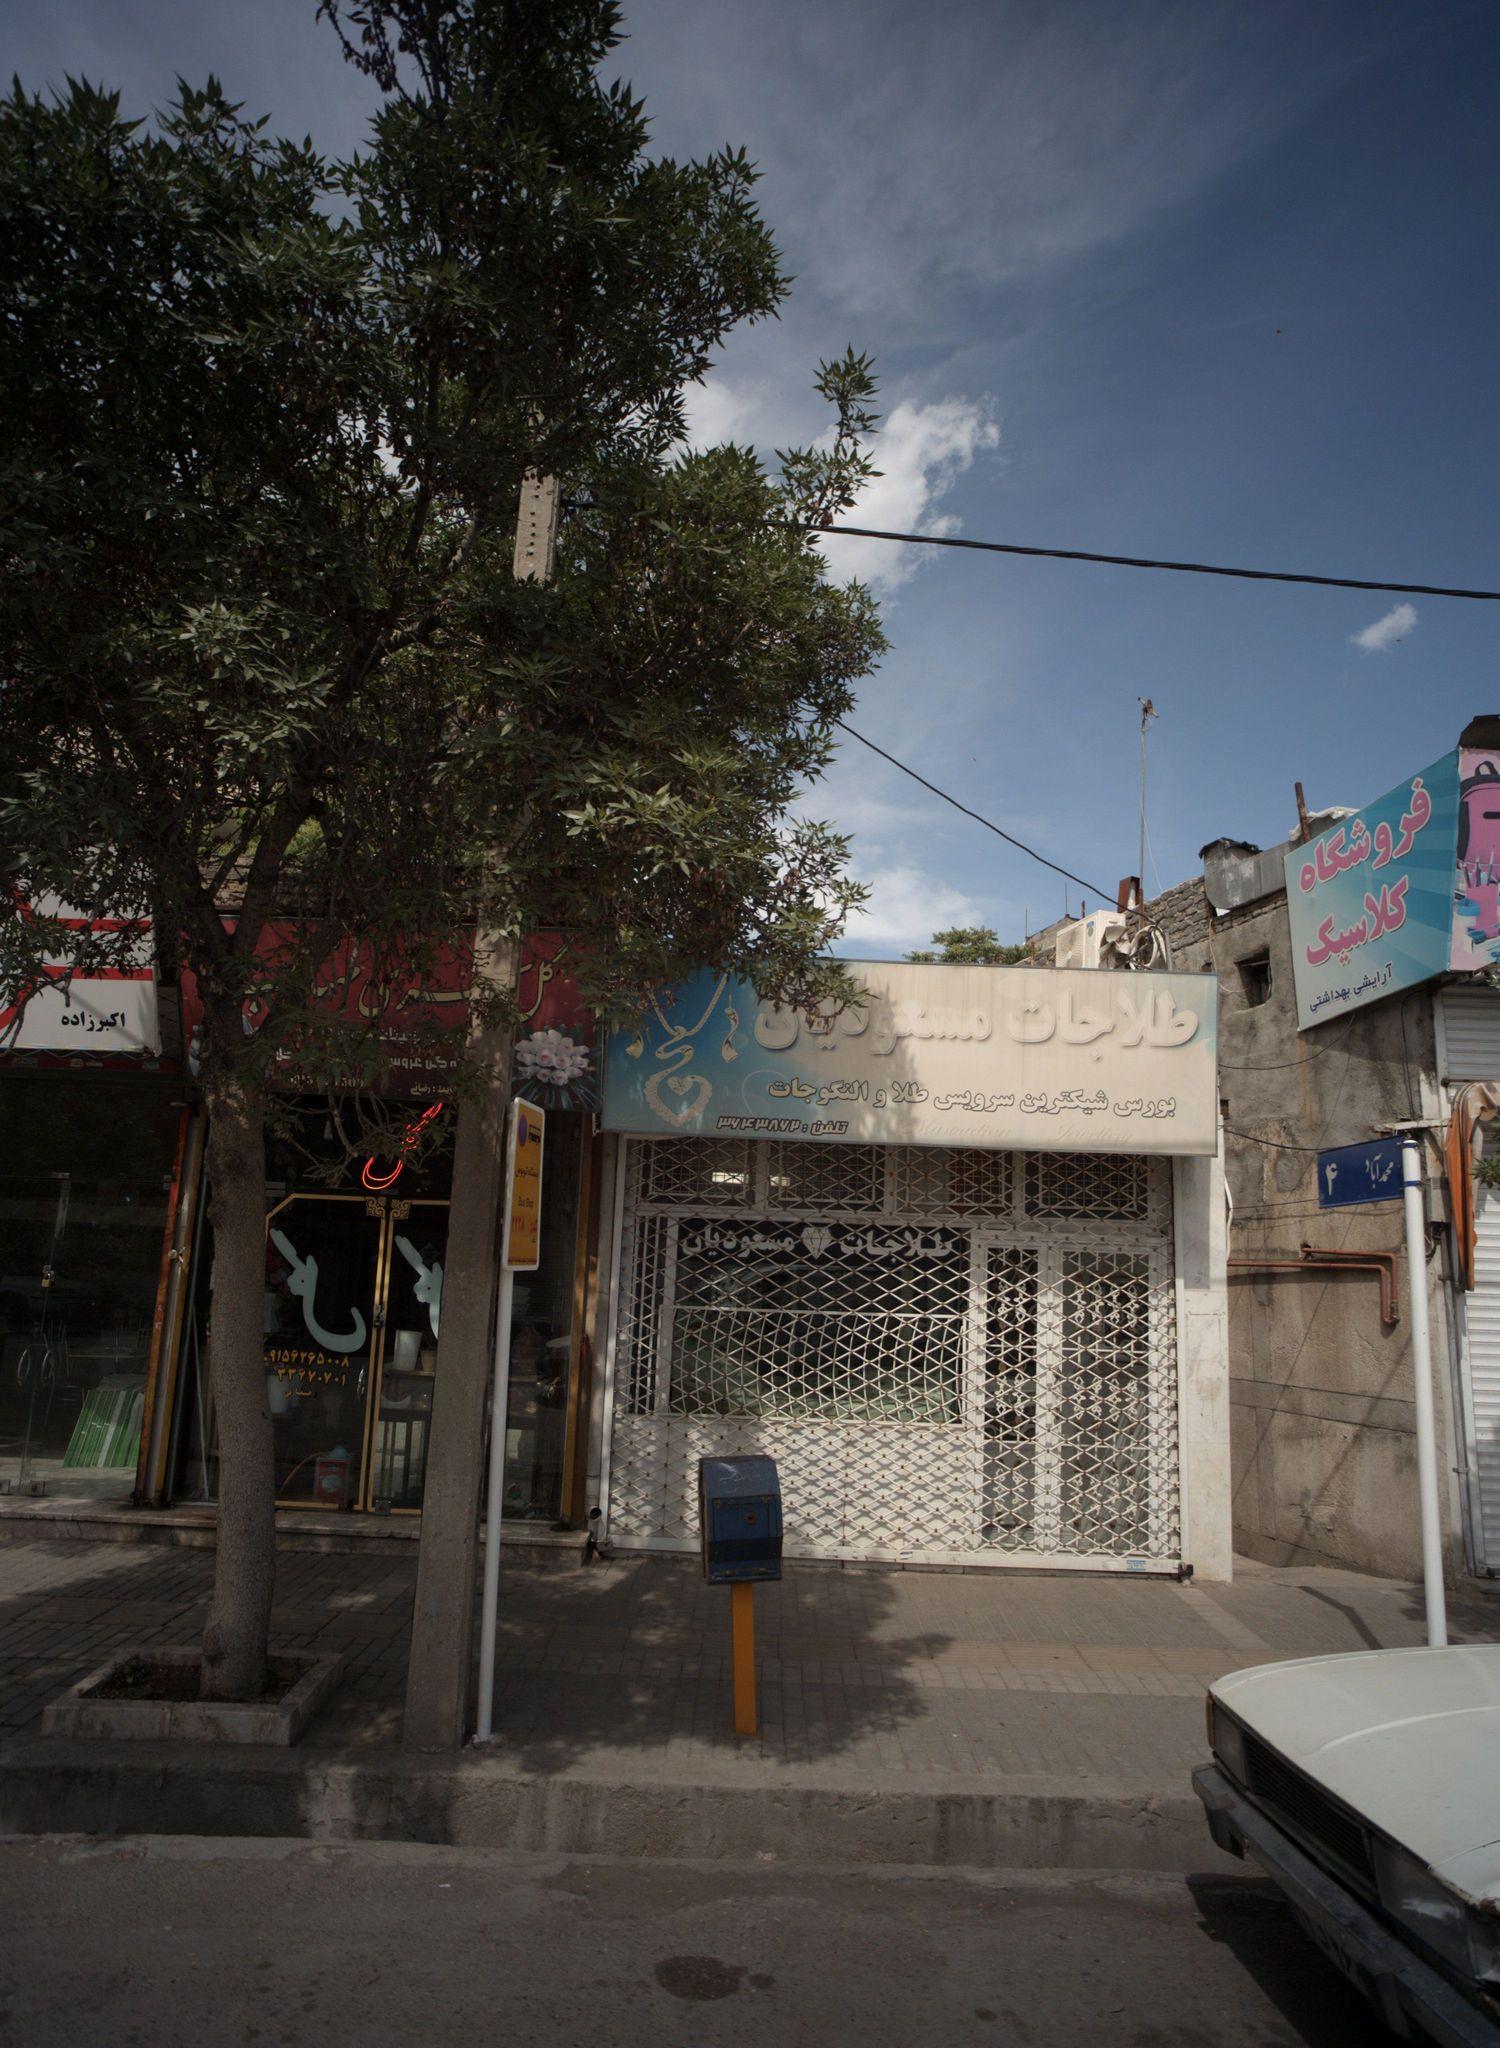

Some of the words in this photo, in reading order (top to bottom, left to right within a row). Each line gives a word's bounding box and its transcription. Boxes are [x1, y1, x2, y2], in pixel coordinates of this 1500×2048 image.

[1298, 776, 1432, 894] فروشگاه
[1305, 874, 1409, 968] کلاسیک
[1353, 963, 1393, 997] آرایشی
[1309, 983, 1351, 1013] بهداشتی
[61, 1011, 126, 1032] اکبرزاده
[1005, 988, 1199, 1062] طلاجات
[872, 1089, 887, 1107] و
[891, 1080, 930, 1105] طلا
[934, 1088, 1016, 1113] سرویس
[1019, 1089, 1110, 1116] شیکترین
[1112, 1096, 1177, 1119] بورس
[681, 1225, 796, 1259] مسعودیان
[839, 1229, 953, 1264] طلاجات
